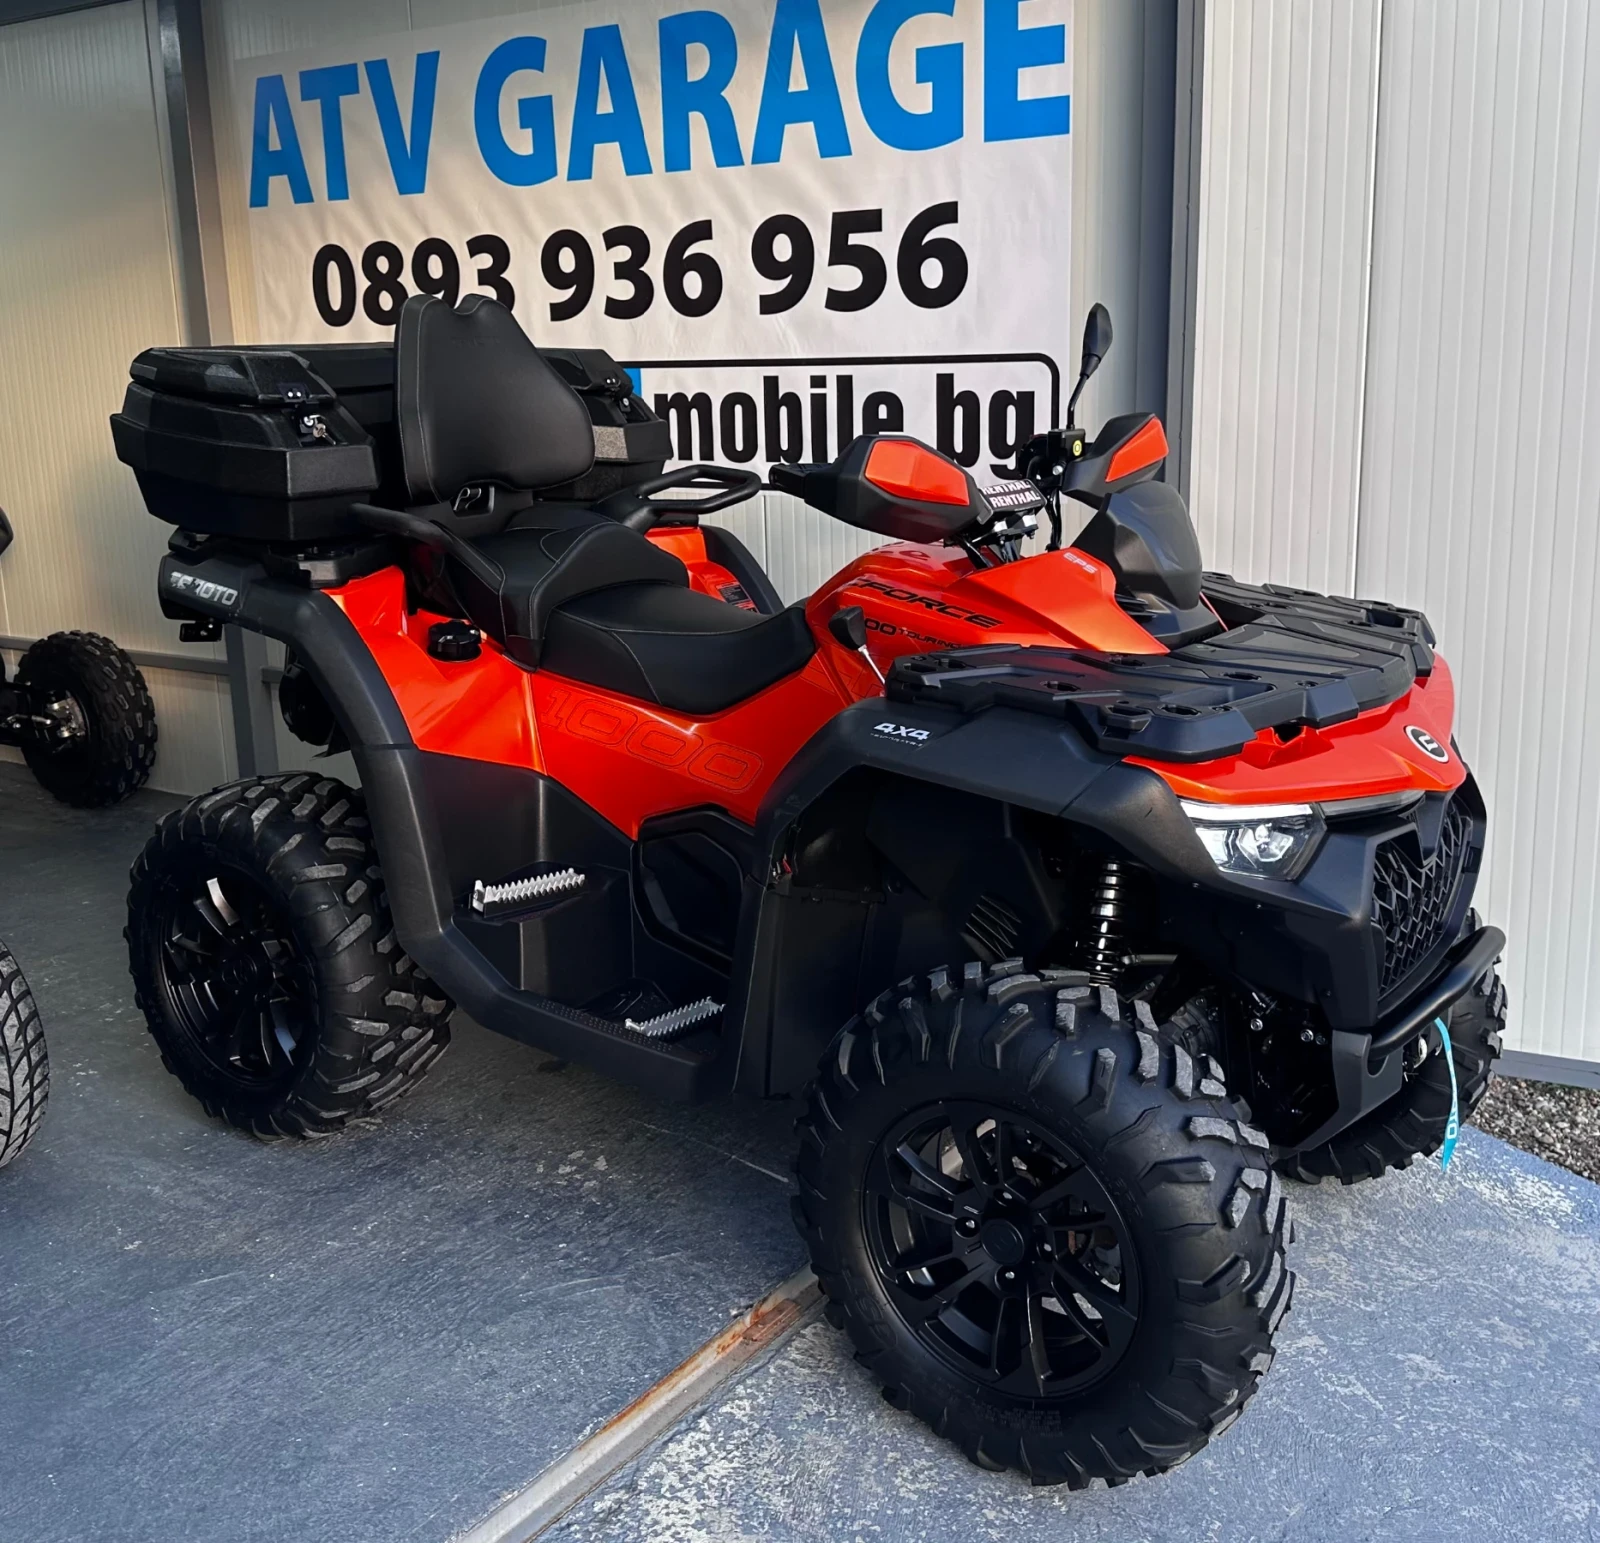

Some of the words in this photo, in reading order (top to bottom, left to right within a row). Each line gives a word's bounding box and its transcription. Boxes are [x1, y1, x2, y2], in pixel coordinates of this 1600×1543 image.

[250, 51, 438, 207] ATV
[474, 0, 1071, 187] GARAGE
[313, 234, 515, 327] 0893
[541, 219, 723, 321] 936
[752, 201, 968, 314] 956
[653, 373, 1035, 479] mobilebg
[989, 490, 1041, 508] RENTHAL
[1063, 551, 1098, 574] EPS
[541, 687, 763, 794] 1000
